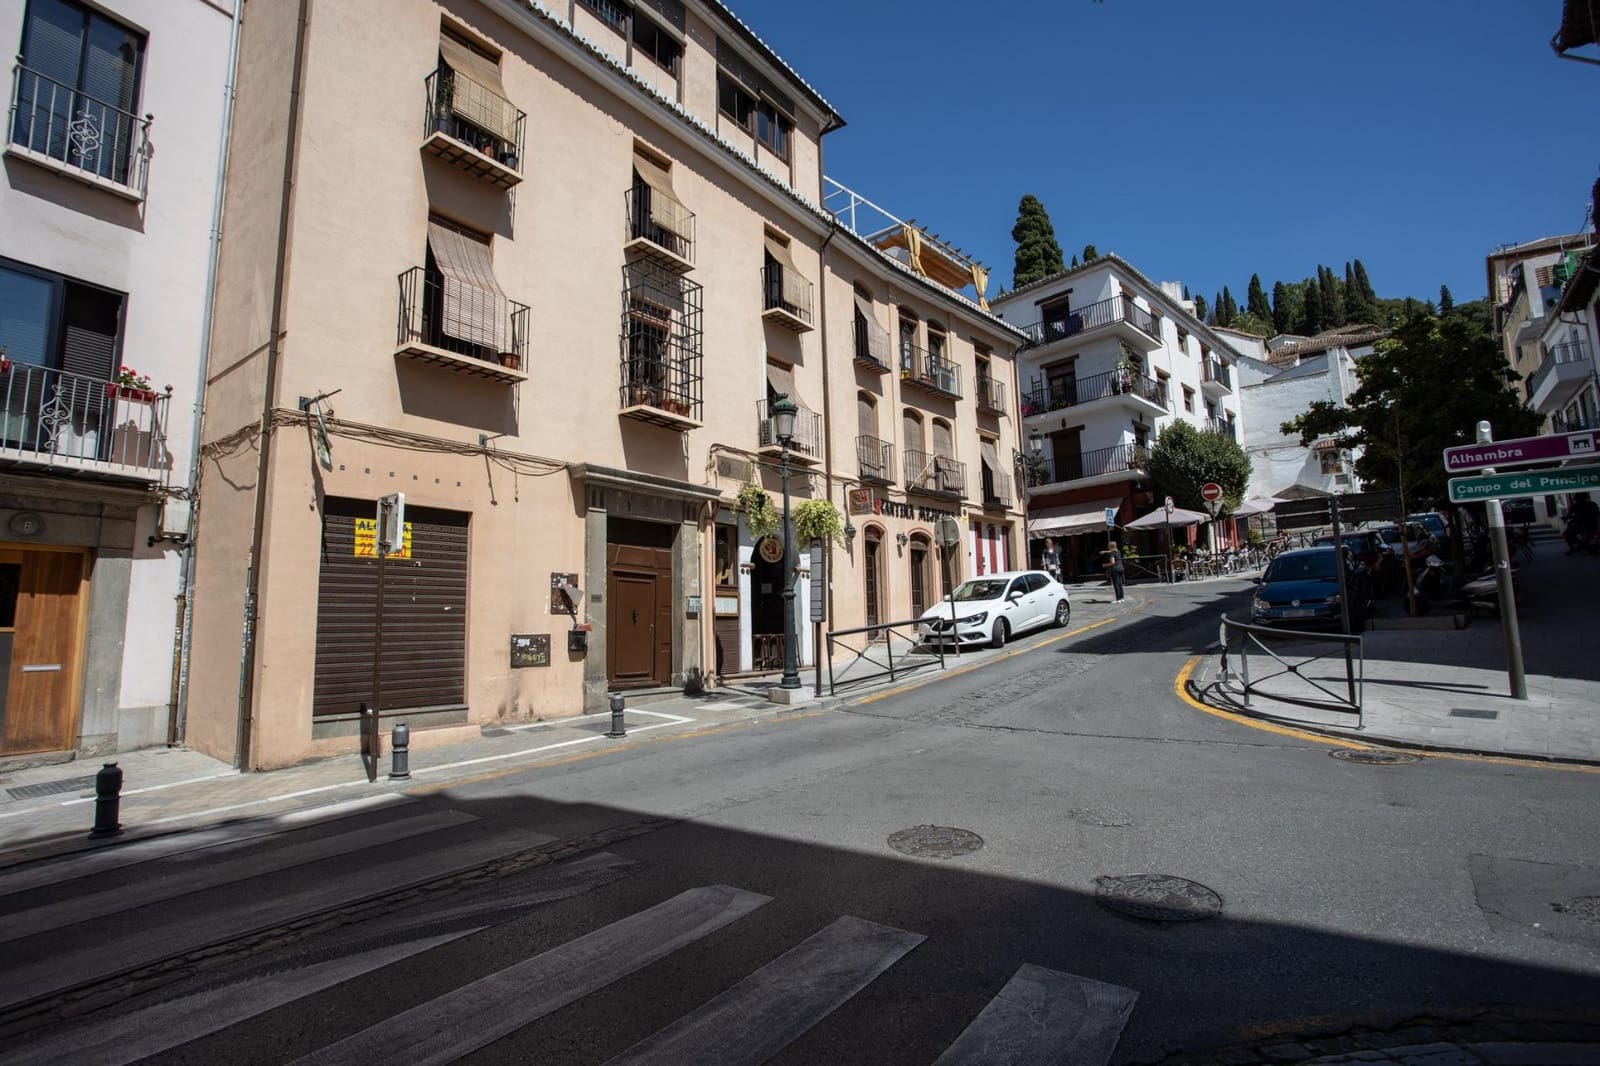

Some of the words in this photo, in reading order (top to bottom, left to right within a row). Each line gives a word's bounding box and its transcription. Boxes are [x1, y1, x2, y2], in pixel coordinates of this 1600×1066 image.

[1450, 448, 1523, 465] Alhambra
[1456, 484, 1501, 494] Campo
[1510, 479, 1532, 489] del
